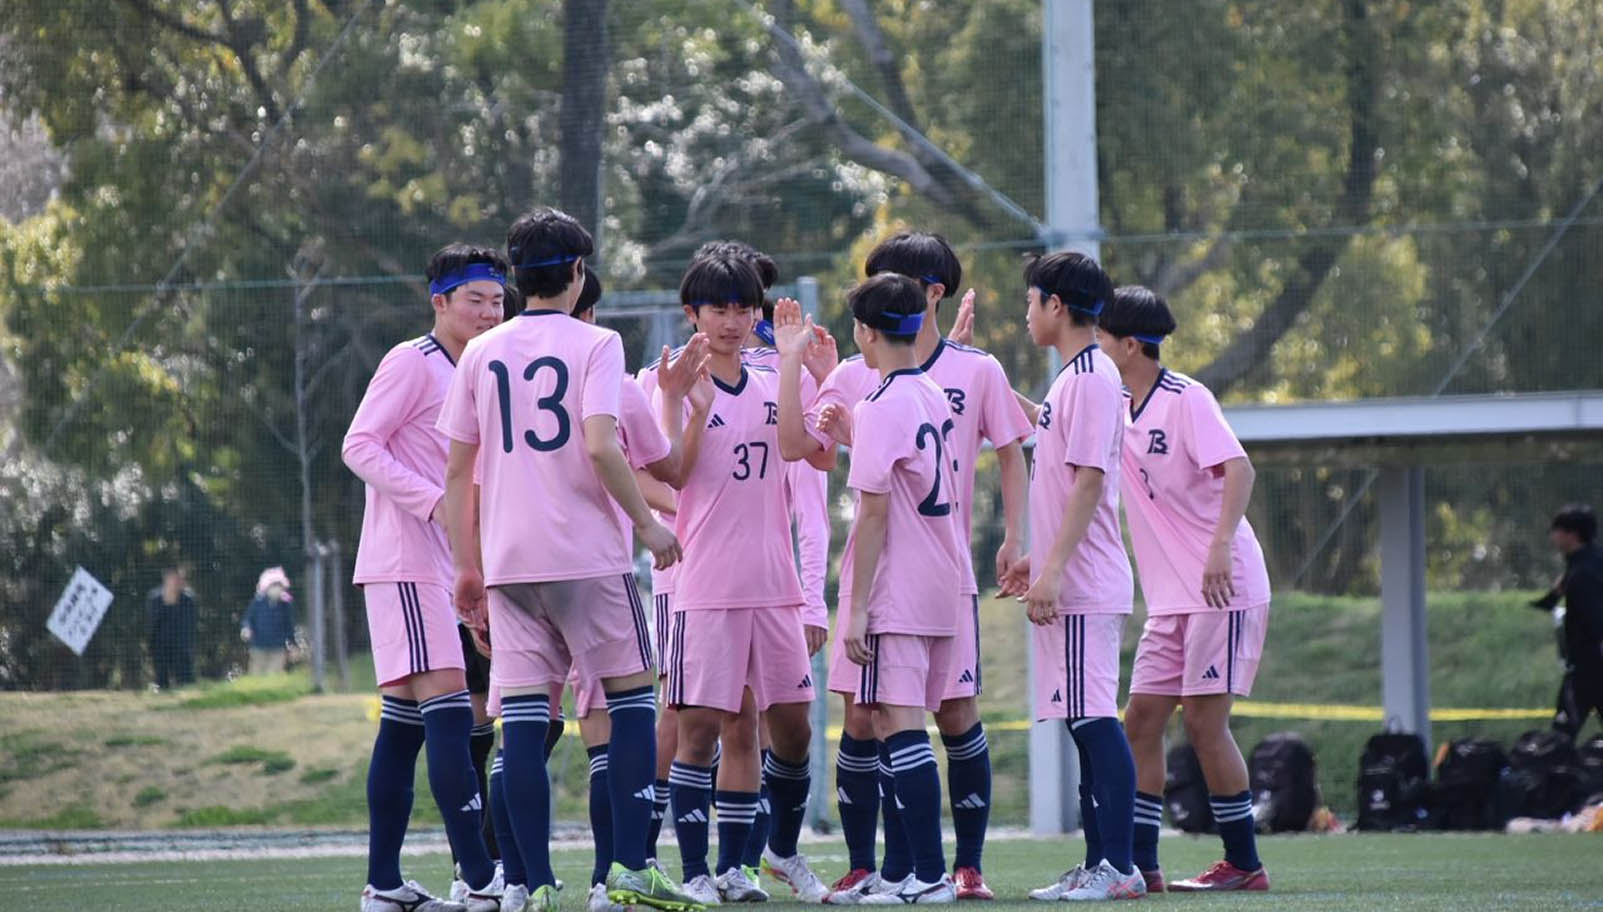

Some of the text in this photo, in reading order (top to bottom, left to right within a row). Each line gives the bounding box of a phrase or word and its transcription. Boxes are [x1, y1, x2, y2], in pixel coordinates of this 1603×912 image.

[488, 356, 570, 453] 13
[733, 442, 768, 480] 37
[916, 418, 954, 516] 2
[1147, 429, 1169, 454] B
